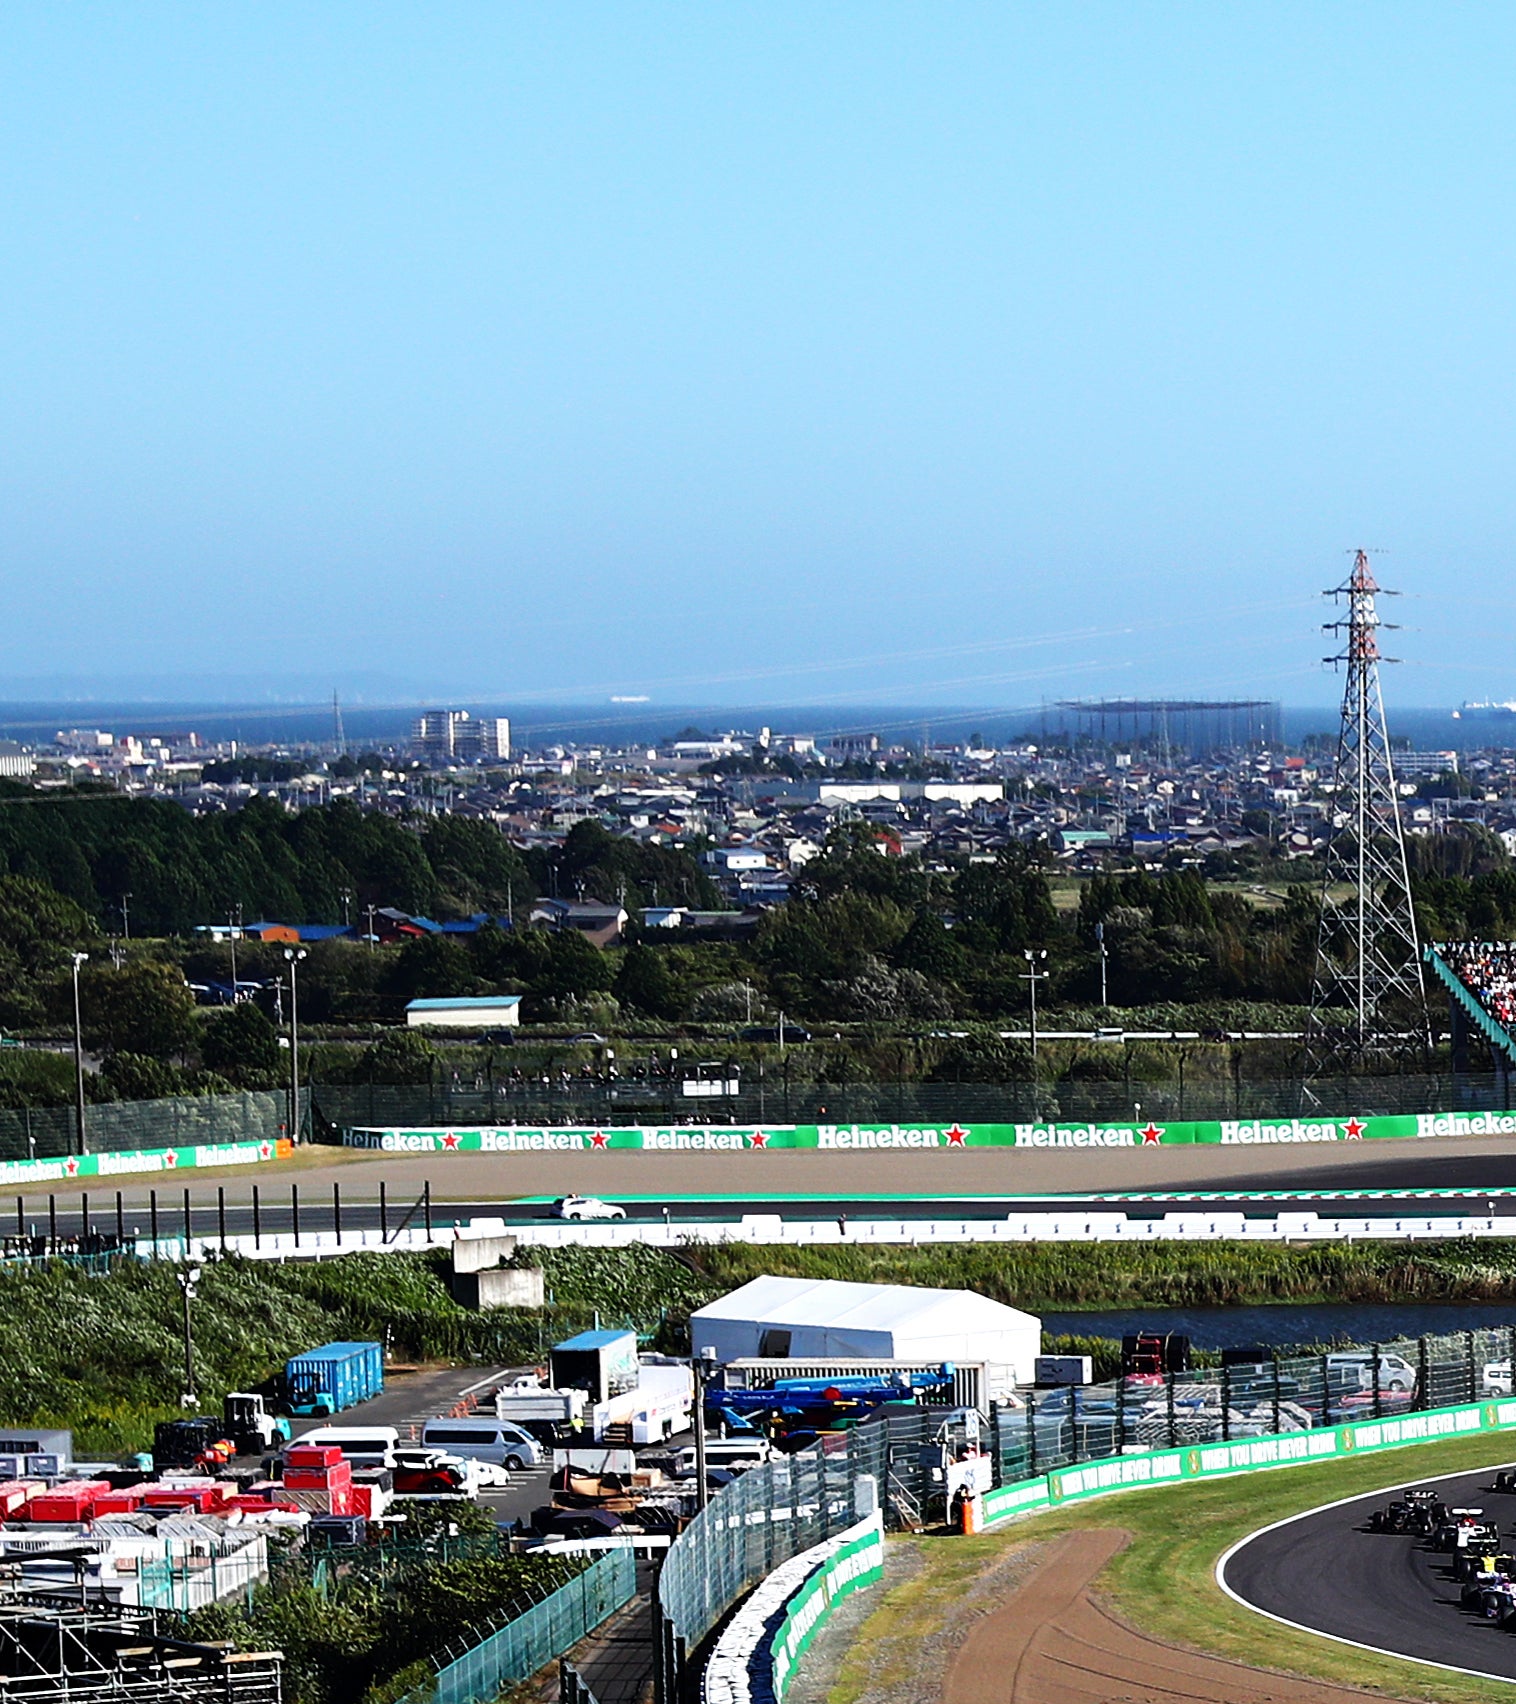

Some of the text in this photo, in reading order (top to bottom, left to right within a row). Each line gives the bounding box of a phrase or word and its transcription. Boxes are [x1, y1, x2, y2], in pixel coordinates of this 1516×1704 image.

[341, 1129, 437, 1151] Heineken
[480, 1130, 584, 1151] Heineken
[641, 1129, 744, 1151] Heineken
[816, 1124, 939, 1149] Heineken
[1014, 1123, 1135, 1147] Heineken
[1220, 1120, 1337, 1145] Heineken
[97, 1150, 163, 1176] Heineken
[194, 1143, 259, 1168] Heineken
